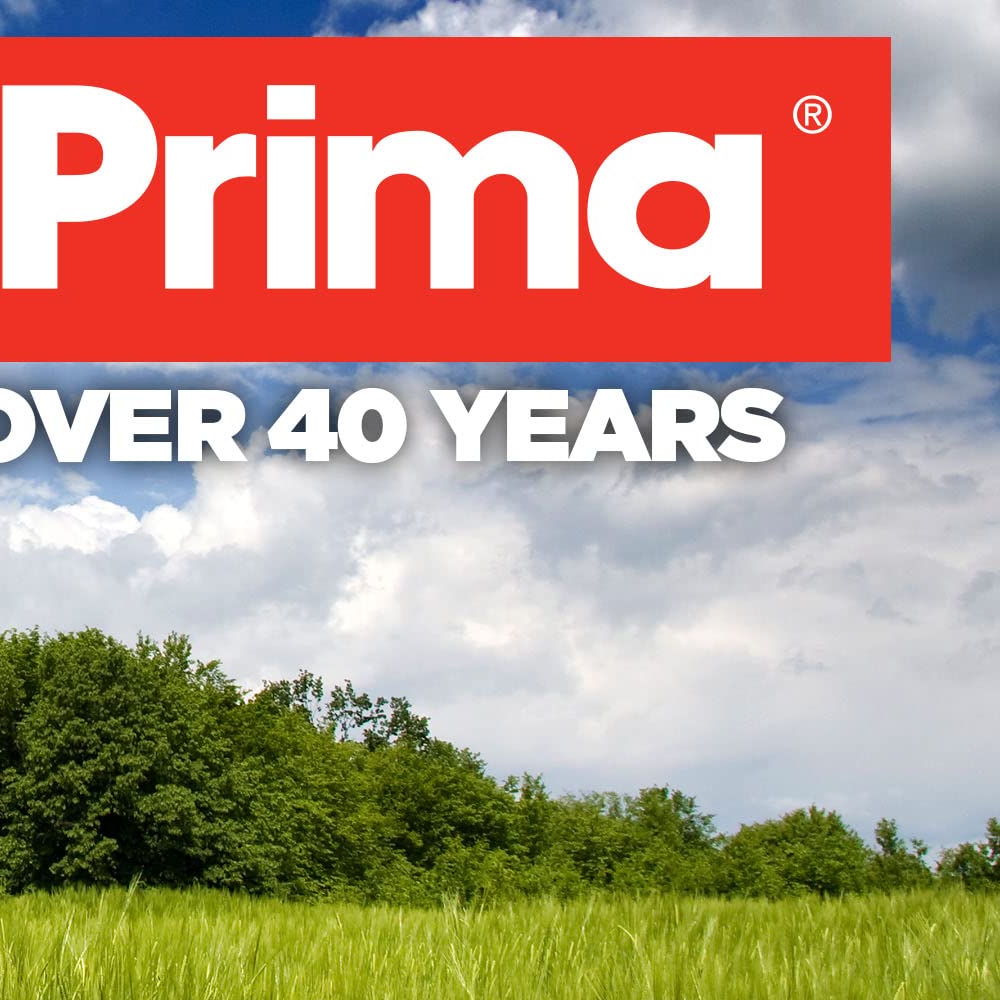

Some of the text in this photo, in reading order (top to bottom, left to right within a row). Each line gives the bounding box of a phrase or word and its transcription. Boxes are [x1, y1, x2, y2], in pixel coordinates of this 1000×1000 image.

[2, 84, 763, 290] Prima
[267, 388, 406, 464] 40
[430, 388, 786, 464] YEARS
